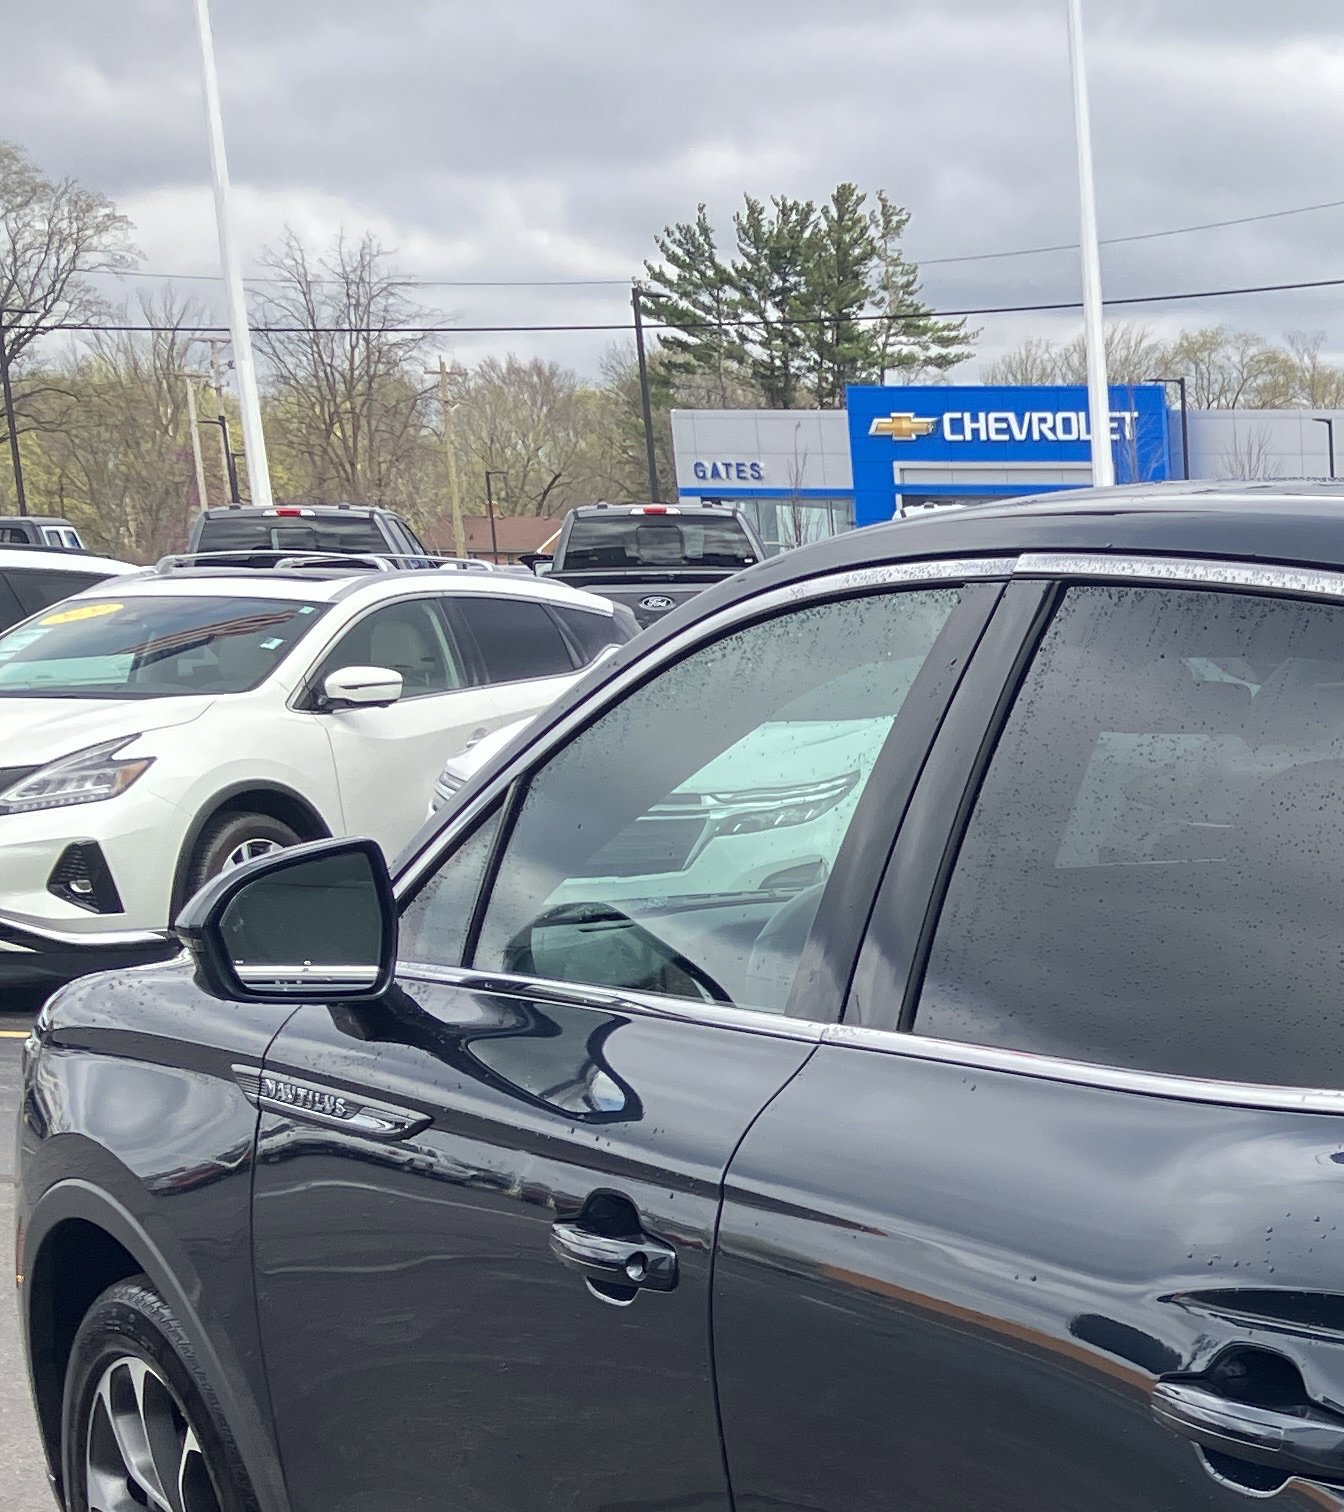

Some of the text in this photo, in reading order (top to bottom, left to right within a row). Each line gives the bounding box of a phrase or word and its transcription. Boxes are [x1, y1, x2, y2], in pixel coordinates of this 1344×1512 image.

[943, 411, 1139, 442] CHEVROLET
[694, 461, 764, 482] GATES
[265, 1078, 347, 1118] NAUTILUS
